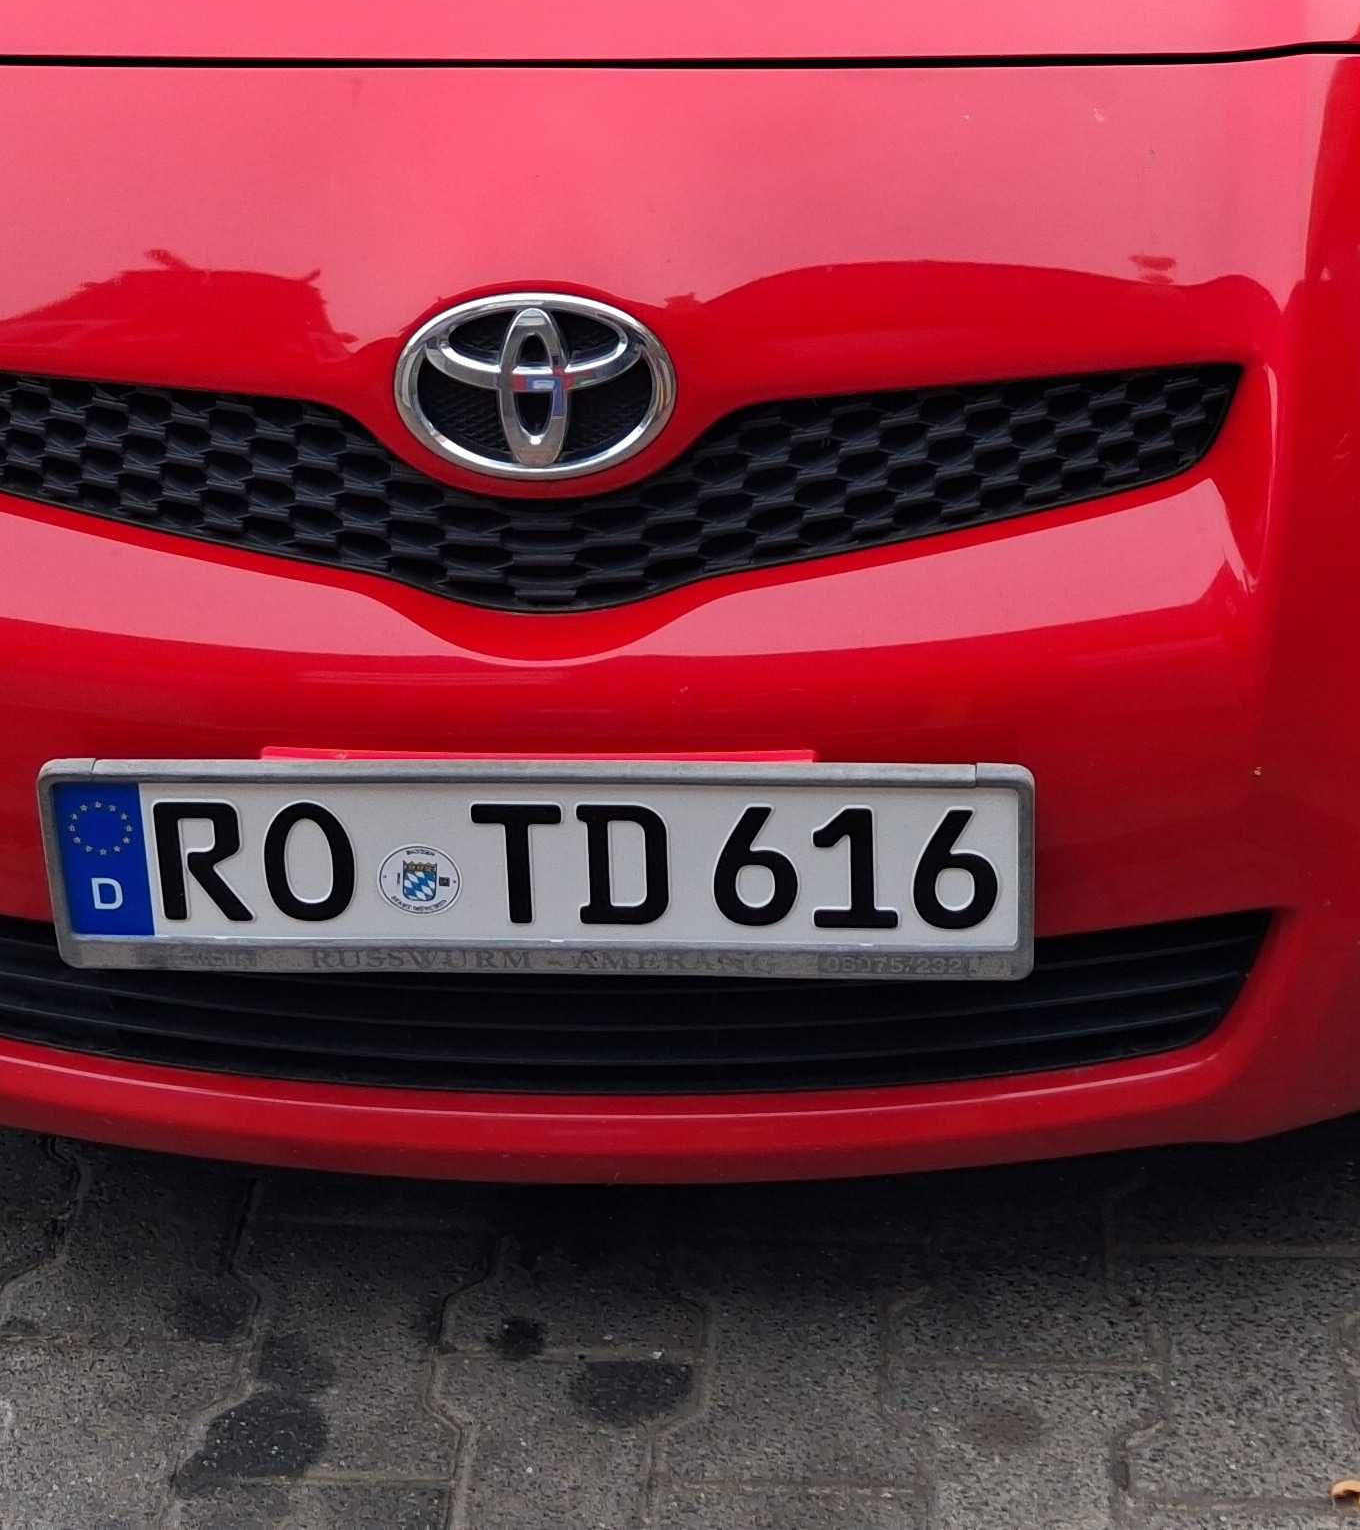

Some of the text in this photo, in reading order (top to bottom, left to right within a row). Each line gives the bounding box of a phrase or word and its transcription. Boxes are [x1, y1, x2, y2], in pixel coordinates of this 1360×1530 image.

[153, 801, 998, 929] RO TD 616
[91, 877, 123, 910] D
[312, 948, 529, 969] RUSSWURM
